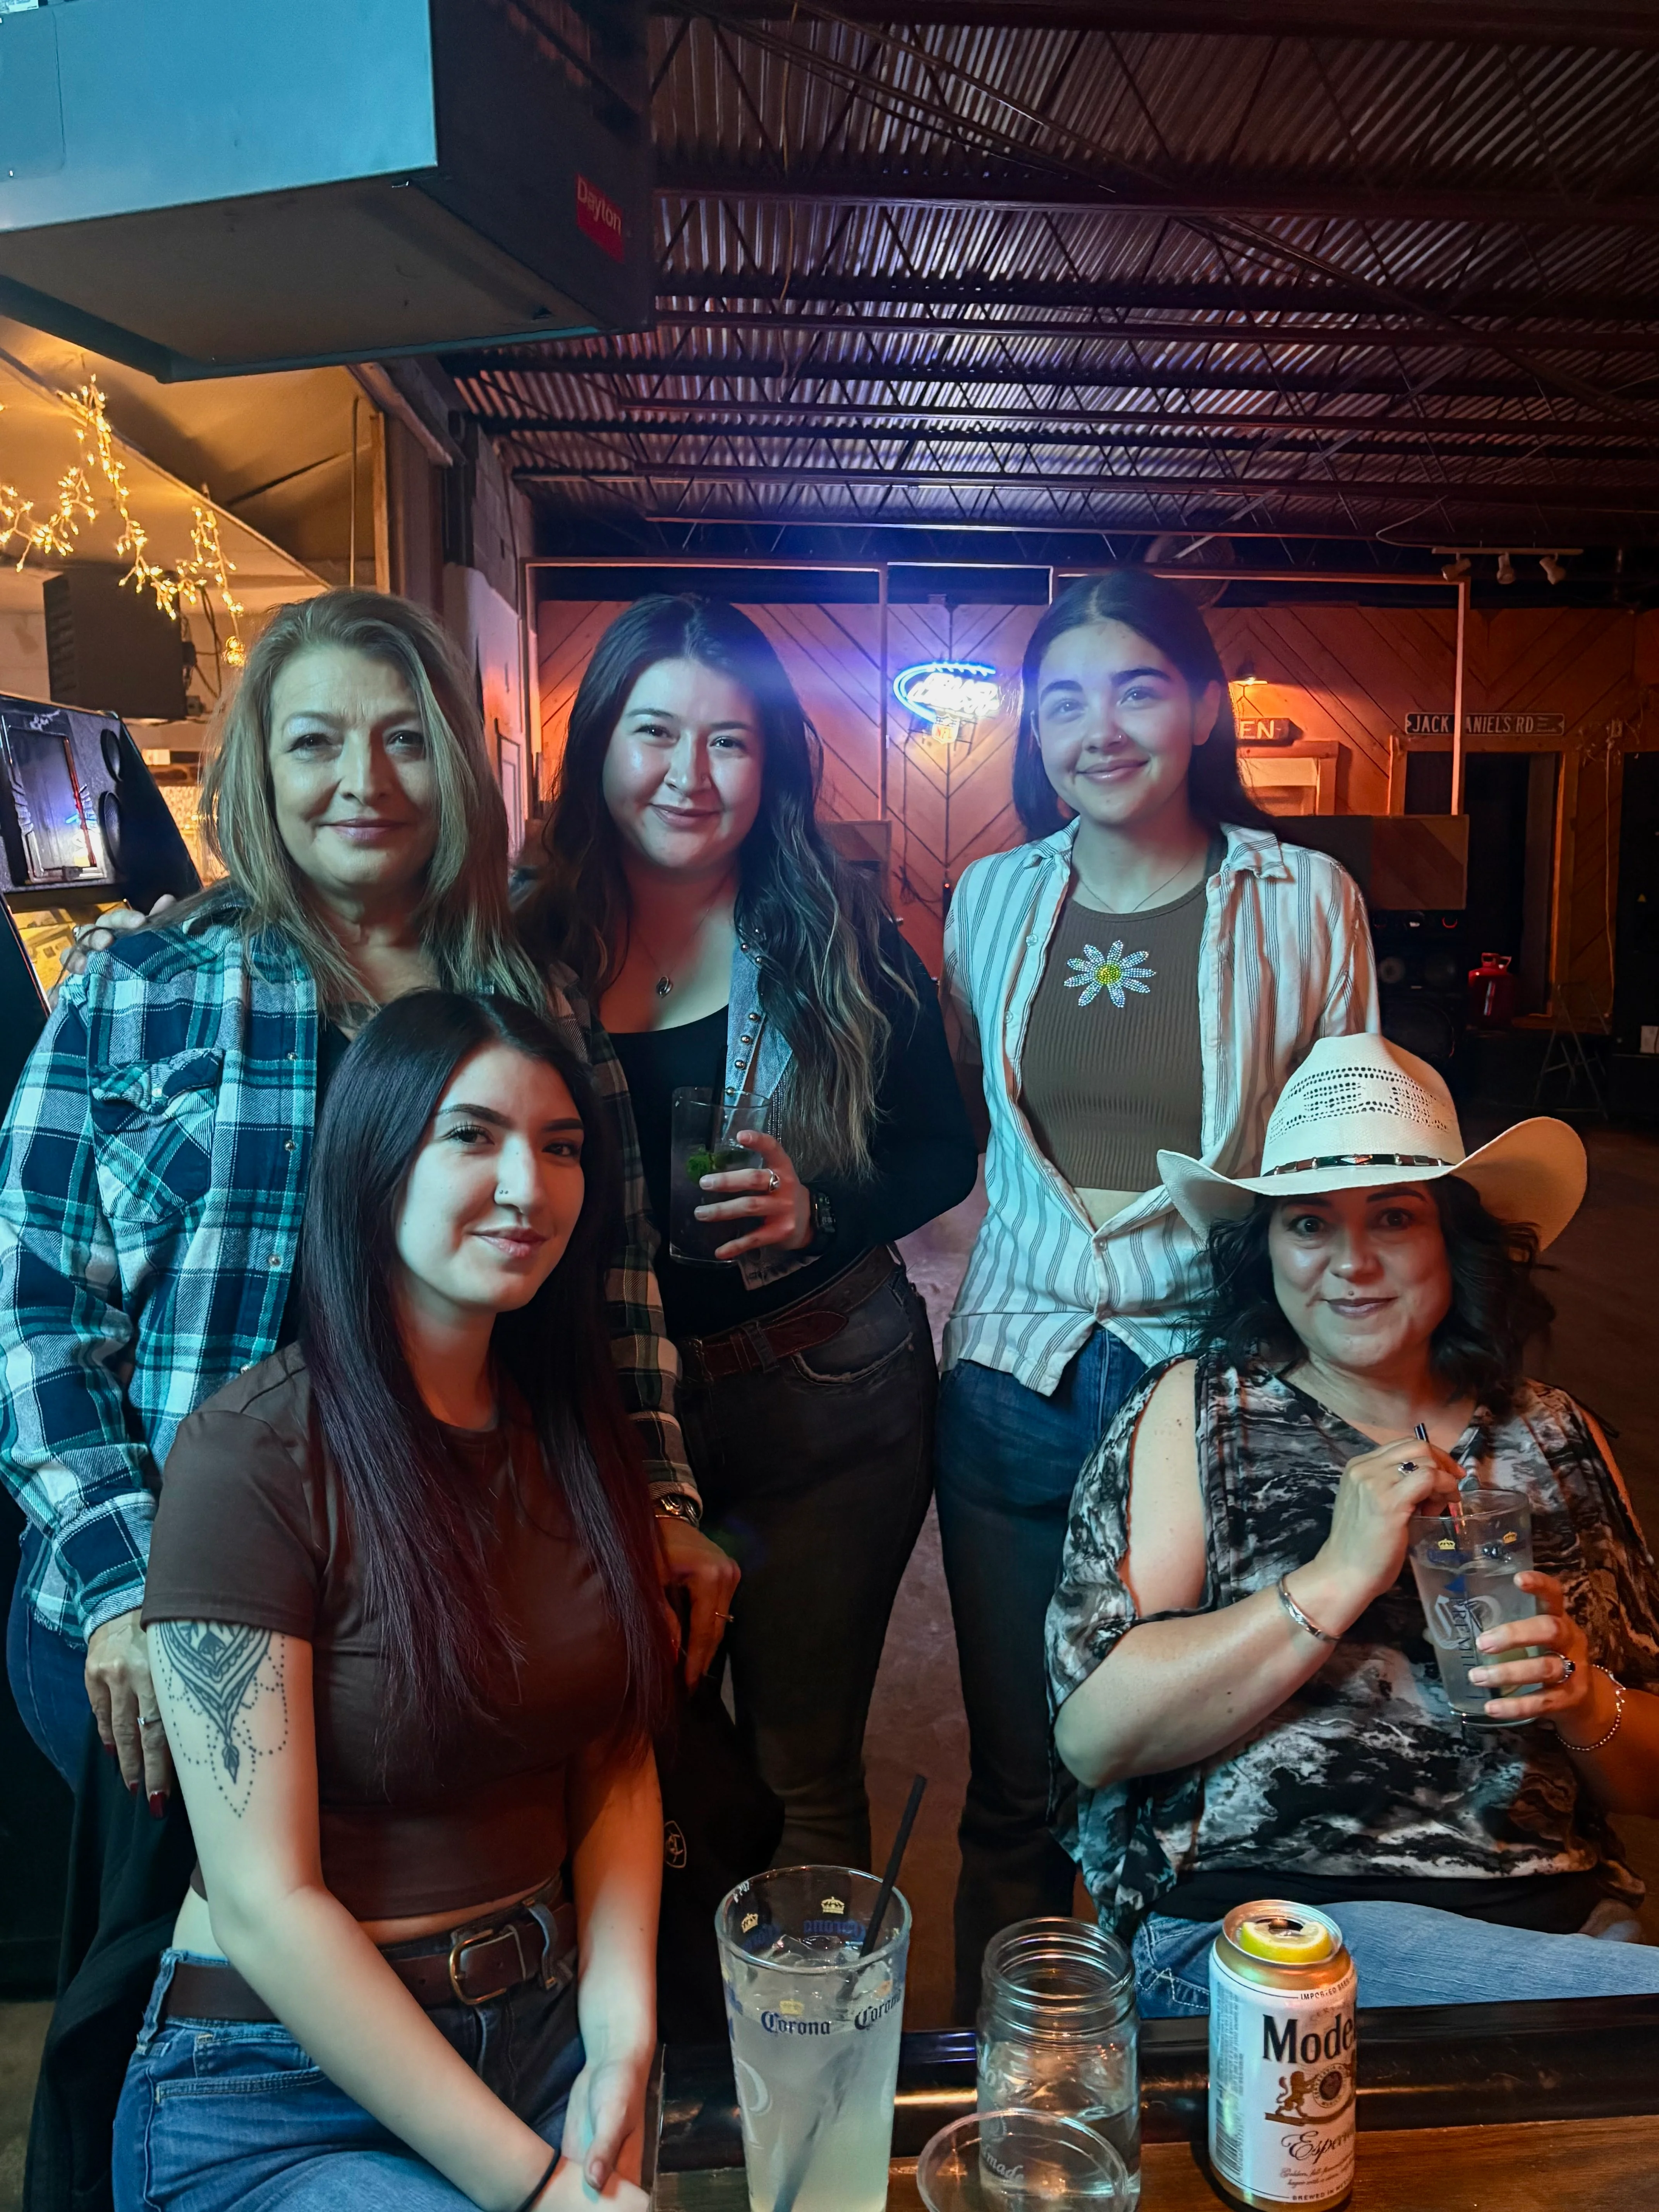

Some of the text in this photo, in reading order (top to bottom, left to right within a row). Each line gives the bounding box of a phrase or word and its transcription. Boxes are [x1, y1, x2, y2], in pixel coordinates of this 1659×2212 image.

[1412, 715, 1449, 733] JACK
[1465, 715, 1511, 733] ANIEL'S
[1516, 716, 1534, 733] RD
[1300, 1987, 1336, 2000] IMPORTED
[761, 2010, 830, 2036] Corona
[1292, 2192, 1325, 2201] BREWED
